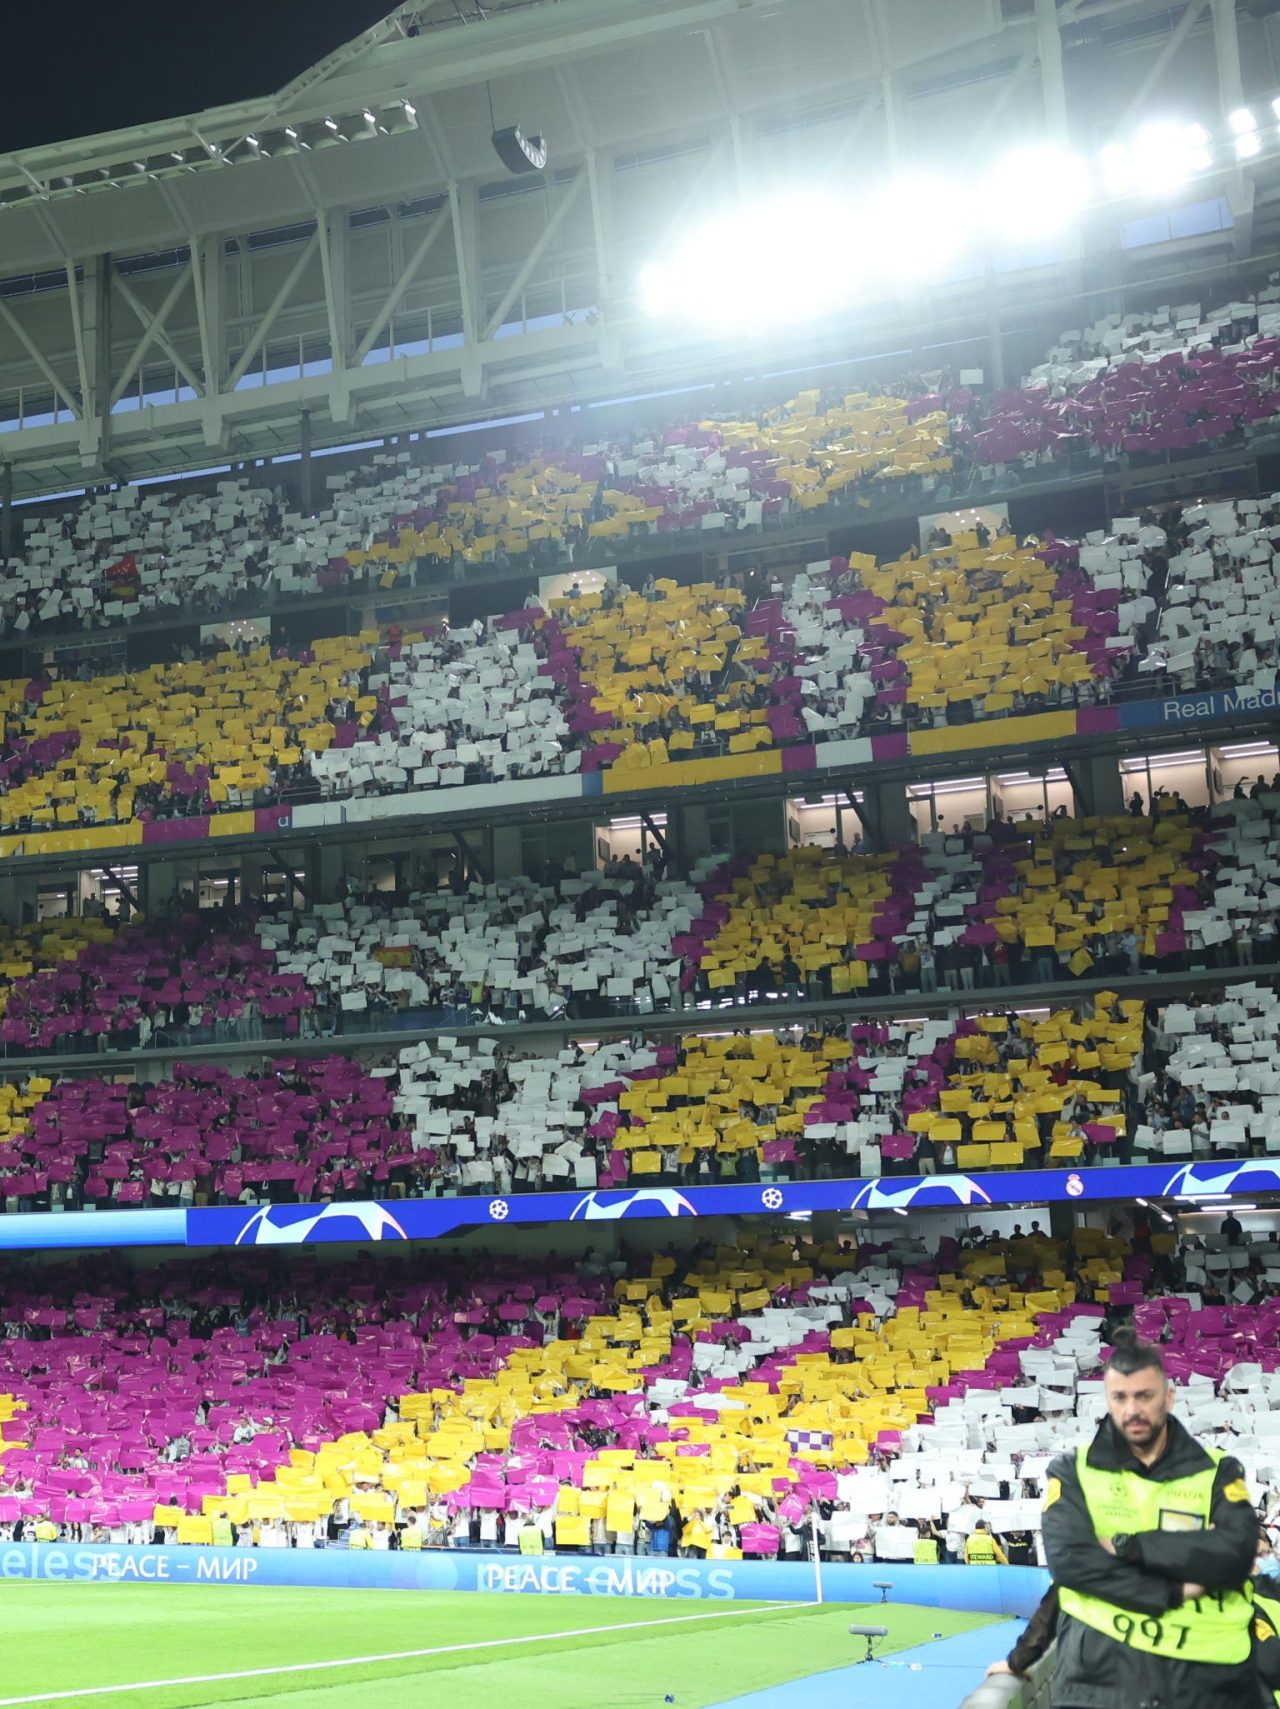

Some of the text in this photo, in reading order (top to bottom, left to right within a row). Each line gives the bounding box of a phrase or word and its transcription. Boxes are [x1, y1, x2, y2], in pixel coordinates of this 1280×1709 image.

[1163, 697, 1215, 721] Real
[92, 1554, 169, 1578] PEACE
[197, 1557, 257, 1580] МИР
[488, 1565, 576, 1591] PEACE
